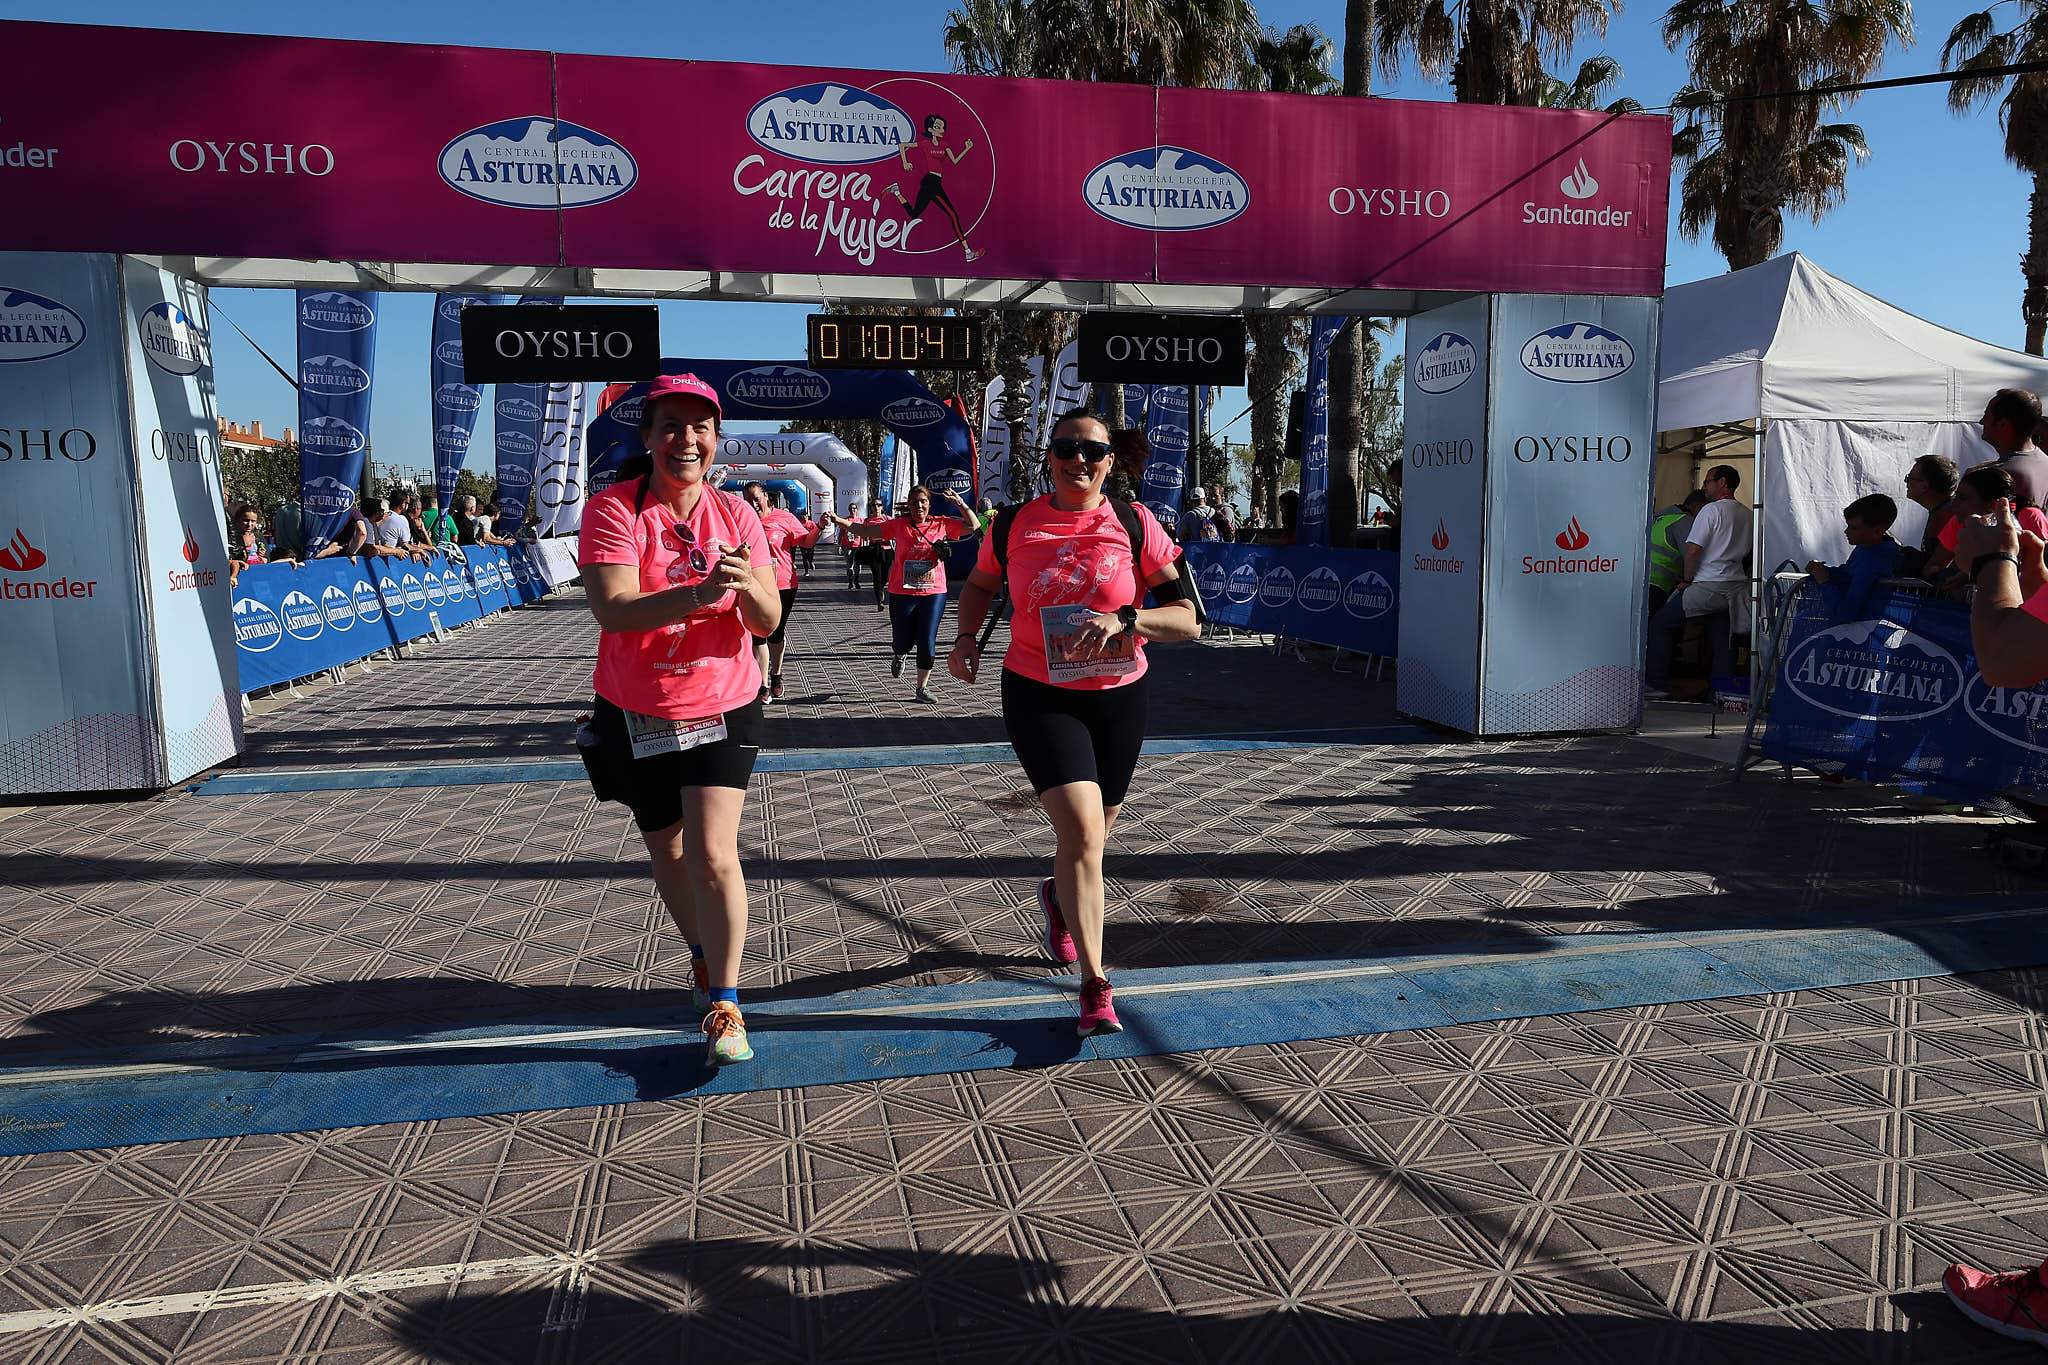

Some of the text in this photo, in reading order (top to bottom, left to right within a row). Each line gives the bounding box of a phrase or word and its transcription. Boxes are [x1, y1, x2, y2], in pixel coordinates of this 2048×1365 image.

[760, 109, 900, 146] ASTURIANA
[786, 108, 897, 122] CENTRAL LECHERA
[169, 139, 335, 176] OYSHO
[484, 147, 616, 160] CENTRAL LECHERA
[455, 148, 623, 186] ASTURIANA
[733, 154, 872, 201] Carrera
[1096, 175, 1237, 210] ASTURIANA
[1122, 174, 1232, 186] CENTRAL LECHERA
[1328, 187, 1451, 218] OYSHO
[1523, 202, 1632, 227] Santander
[768, 198, 923, 266] de la Mujer
[11, 313, 66, 321] LECHERA
[147, 321, 202, 362] ASTURIANA
[495, 330, 633, 359] OYSHO
[1105, 335, 1223, 363] OYSHO
[1528, 345, 1626, 369] ASTURIANA
[1417, 357, 1472, 383] ASTURIANA
[735, 378, 823, 399] ASTURIANA
[887, 409, 941, 421] ASTURIANA
[151, 429, 212, 464] OYSHO
[724, 439, 805, 456] OYSHO
[1412, 438, 1473, 468] OYSHO
[1514, 436, 1632, 463] OYSHO
[1414, 553, 1464, 574] Santander
[1522, 555, 1619, 575] Santander
[168, 567, 217, 592] Santander
[234, 620, 280, 641] ASTURIANA
[285, 611, 322, 630] ASTURIANA
[1826, 648, 1946, 673] CENTRAL LECHERA
[1793, 648, 1943, 704] ASTURIANA
[643, 740, 673, 751] OYSHO
